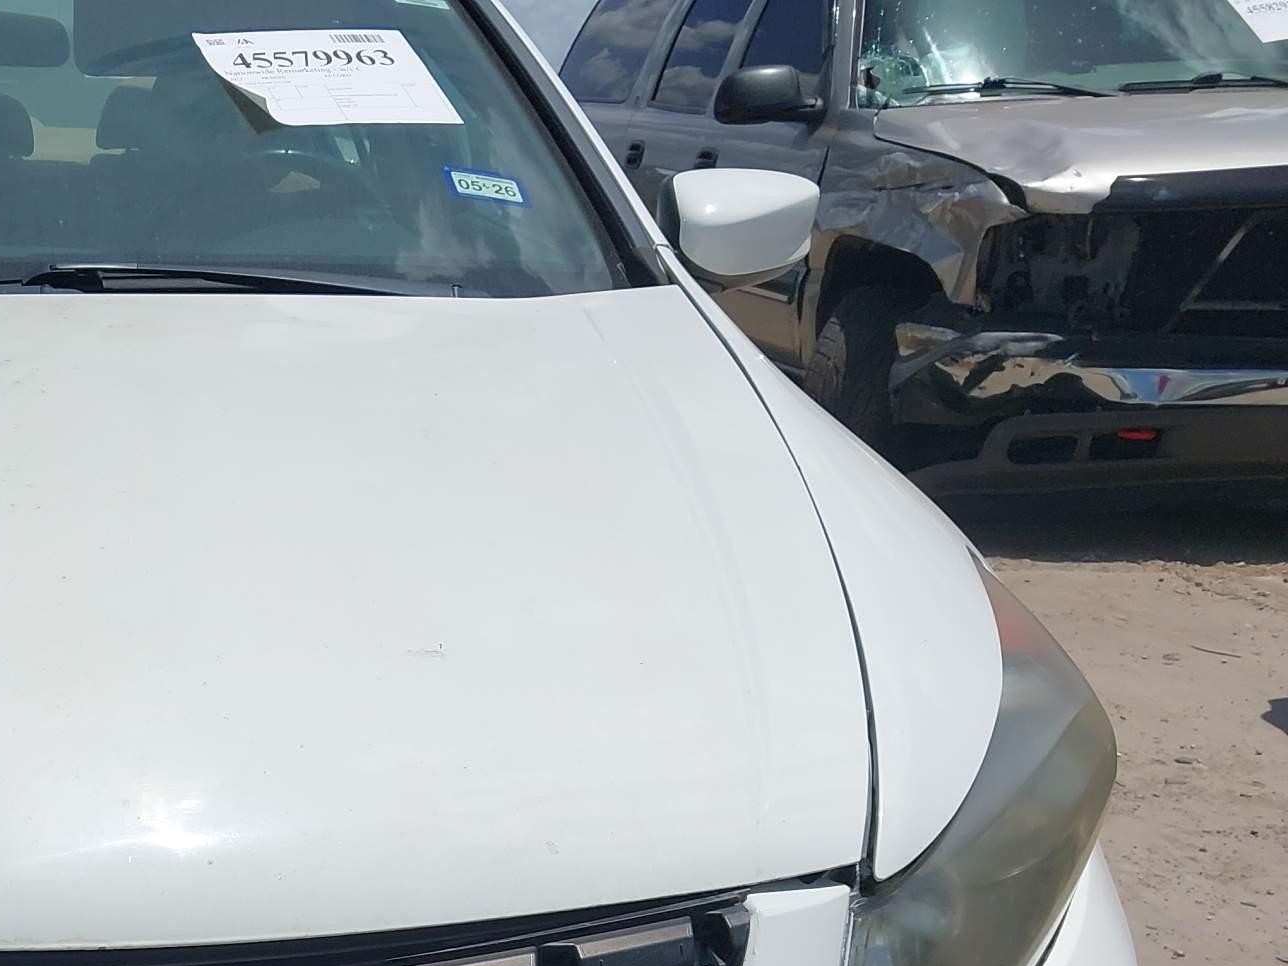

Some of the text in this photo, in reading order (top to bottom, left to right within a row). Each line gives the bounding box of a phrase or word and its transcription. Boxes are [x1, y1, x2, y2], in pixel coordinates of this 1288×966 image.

[232, 49, 396, 69] 45579963
[457, 178, 517, 198] 05 26
